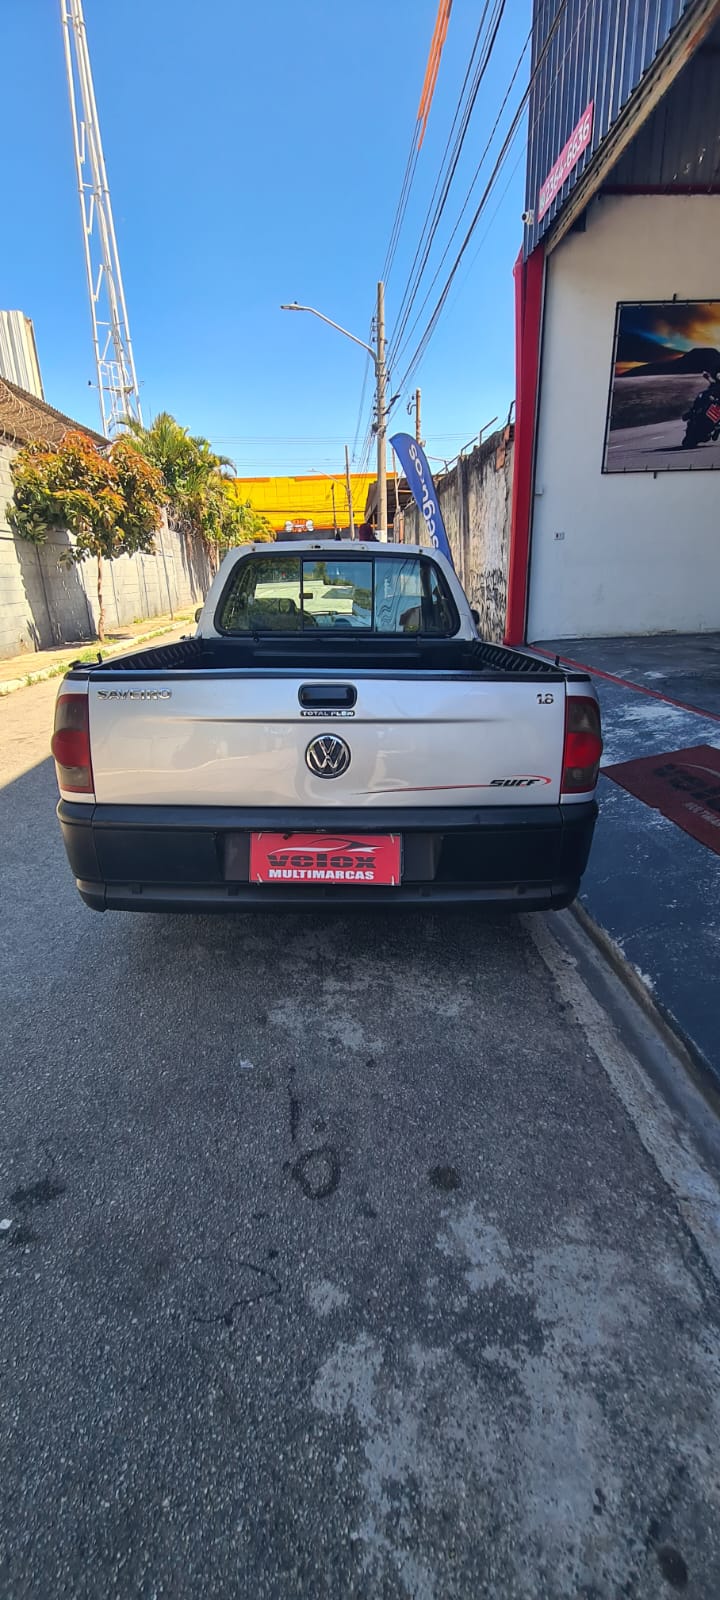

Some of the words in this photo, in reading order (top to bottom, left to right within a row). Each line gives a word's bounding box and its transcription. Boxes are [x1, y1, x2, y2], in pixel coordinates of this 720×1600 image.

[97, 689, 172, 701] SAVEIRO
[266, 853, 377, 869] velox
[268, 869, 375, 880] MULTIMARCAS
